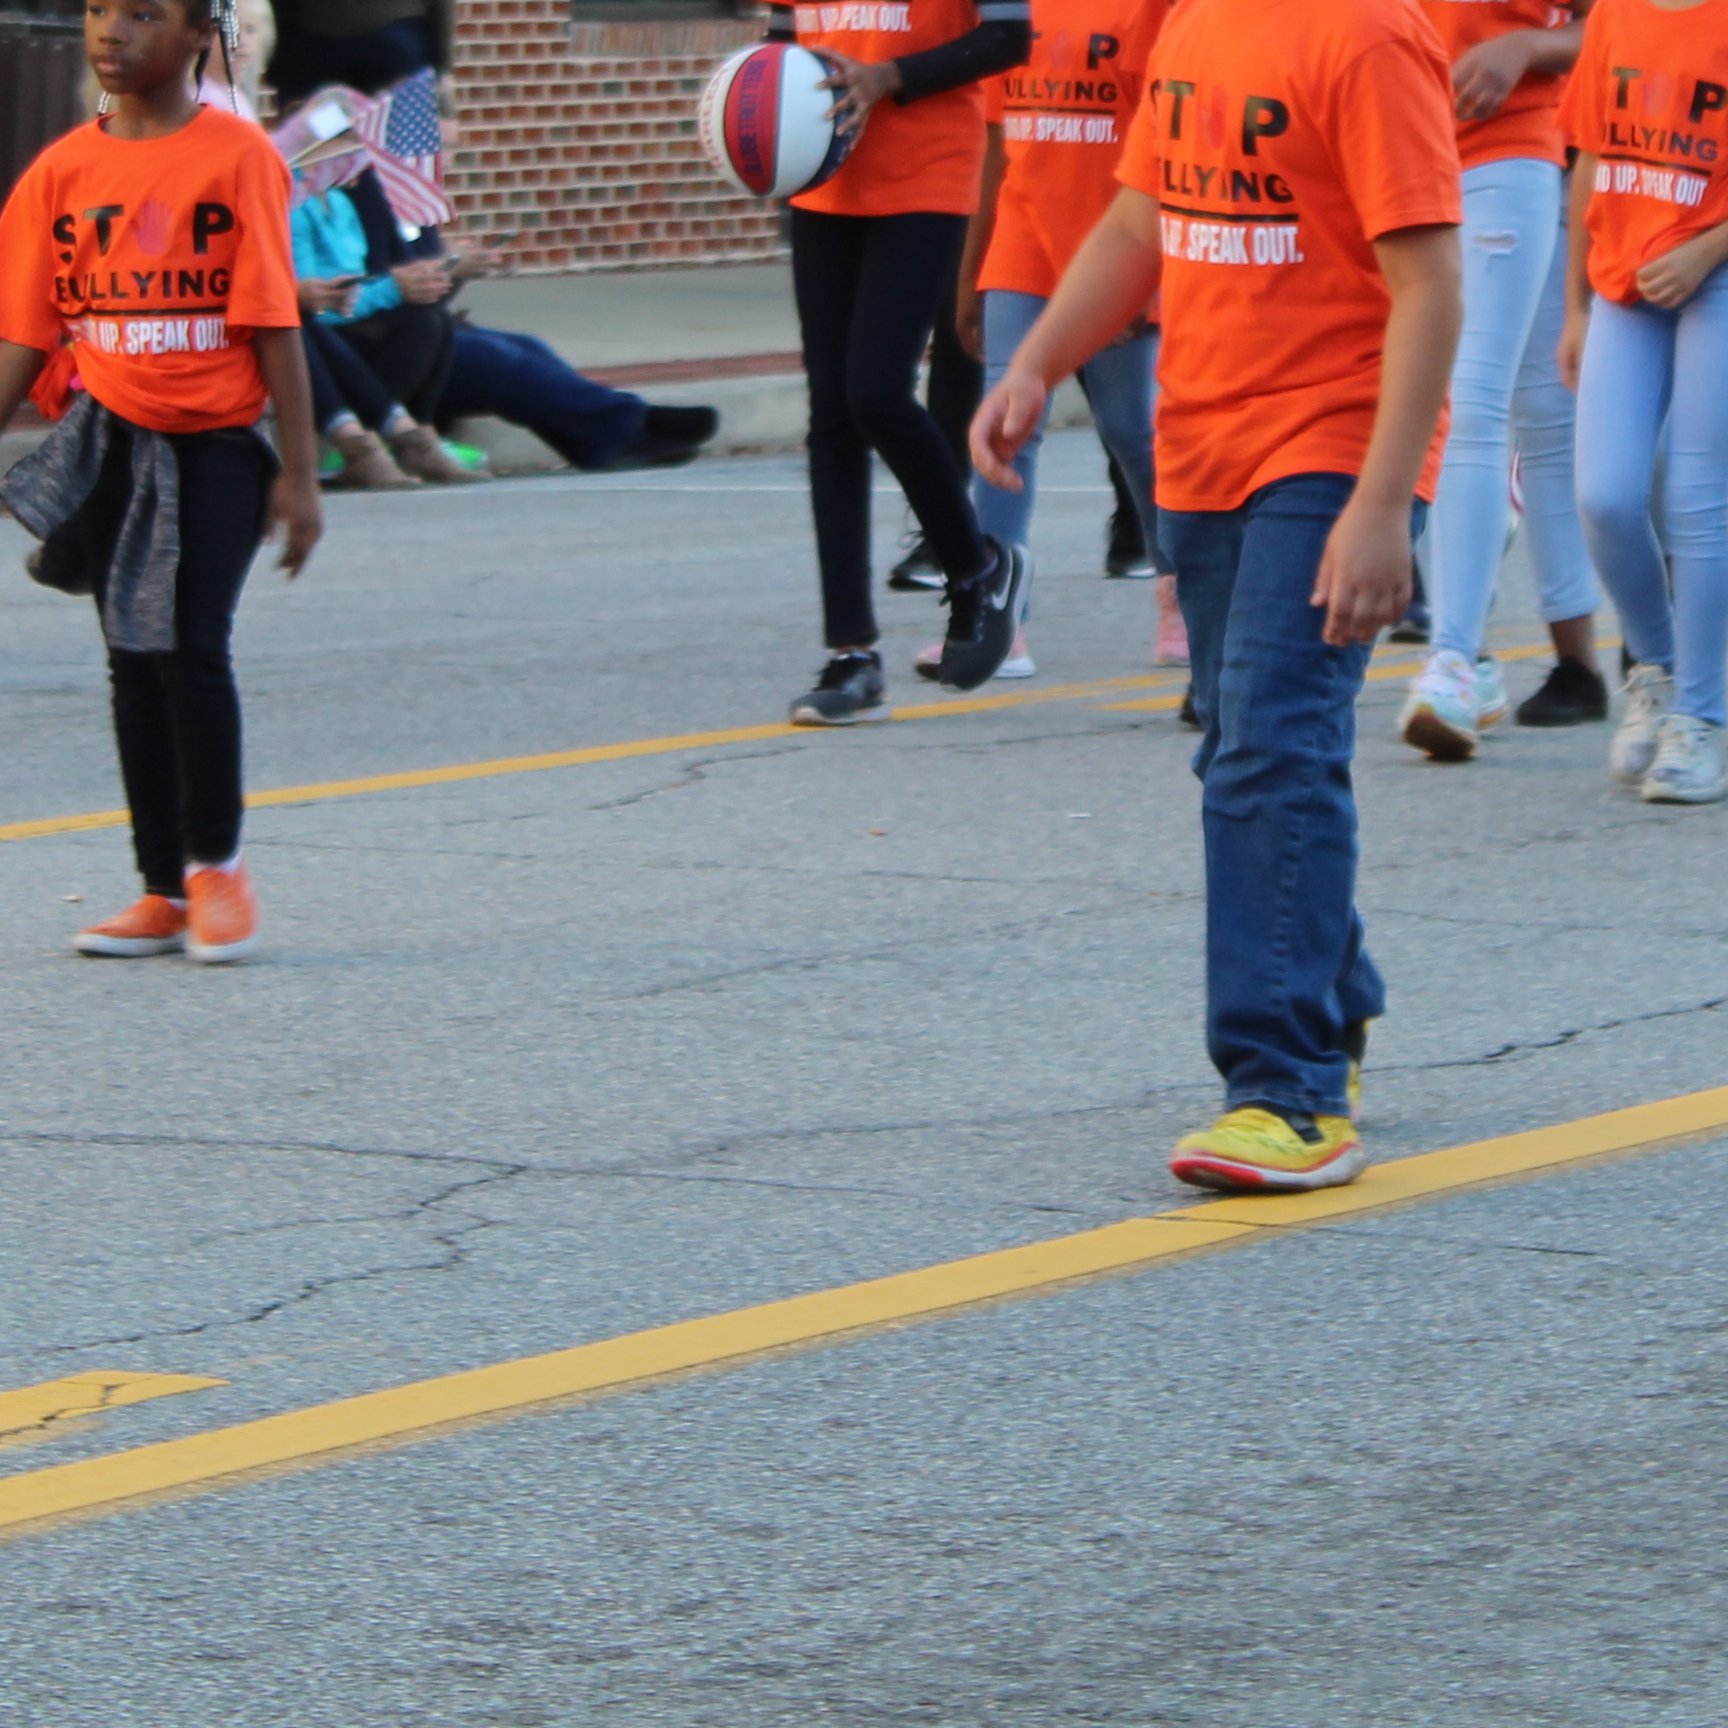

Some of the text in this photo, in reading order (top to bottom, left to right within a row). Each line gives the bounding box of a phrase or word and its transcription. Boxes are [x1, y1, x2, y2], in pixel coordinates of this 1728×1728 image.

[1004, 77, 1118, 103] ULLYING
[1614, 165, 1640, 195] UP.
[1186, 221, 1250, 264] SPEAK
[1252, 225, 1305, 266] OUT.
[126, 319, 190, 355] SPEAK
